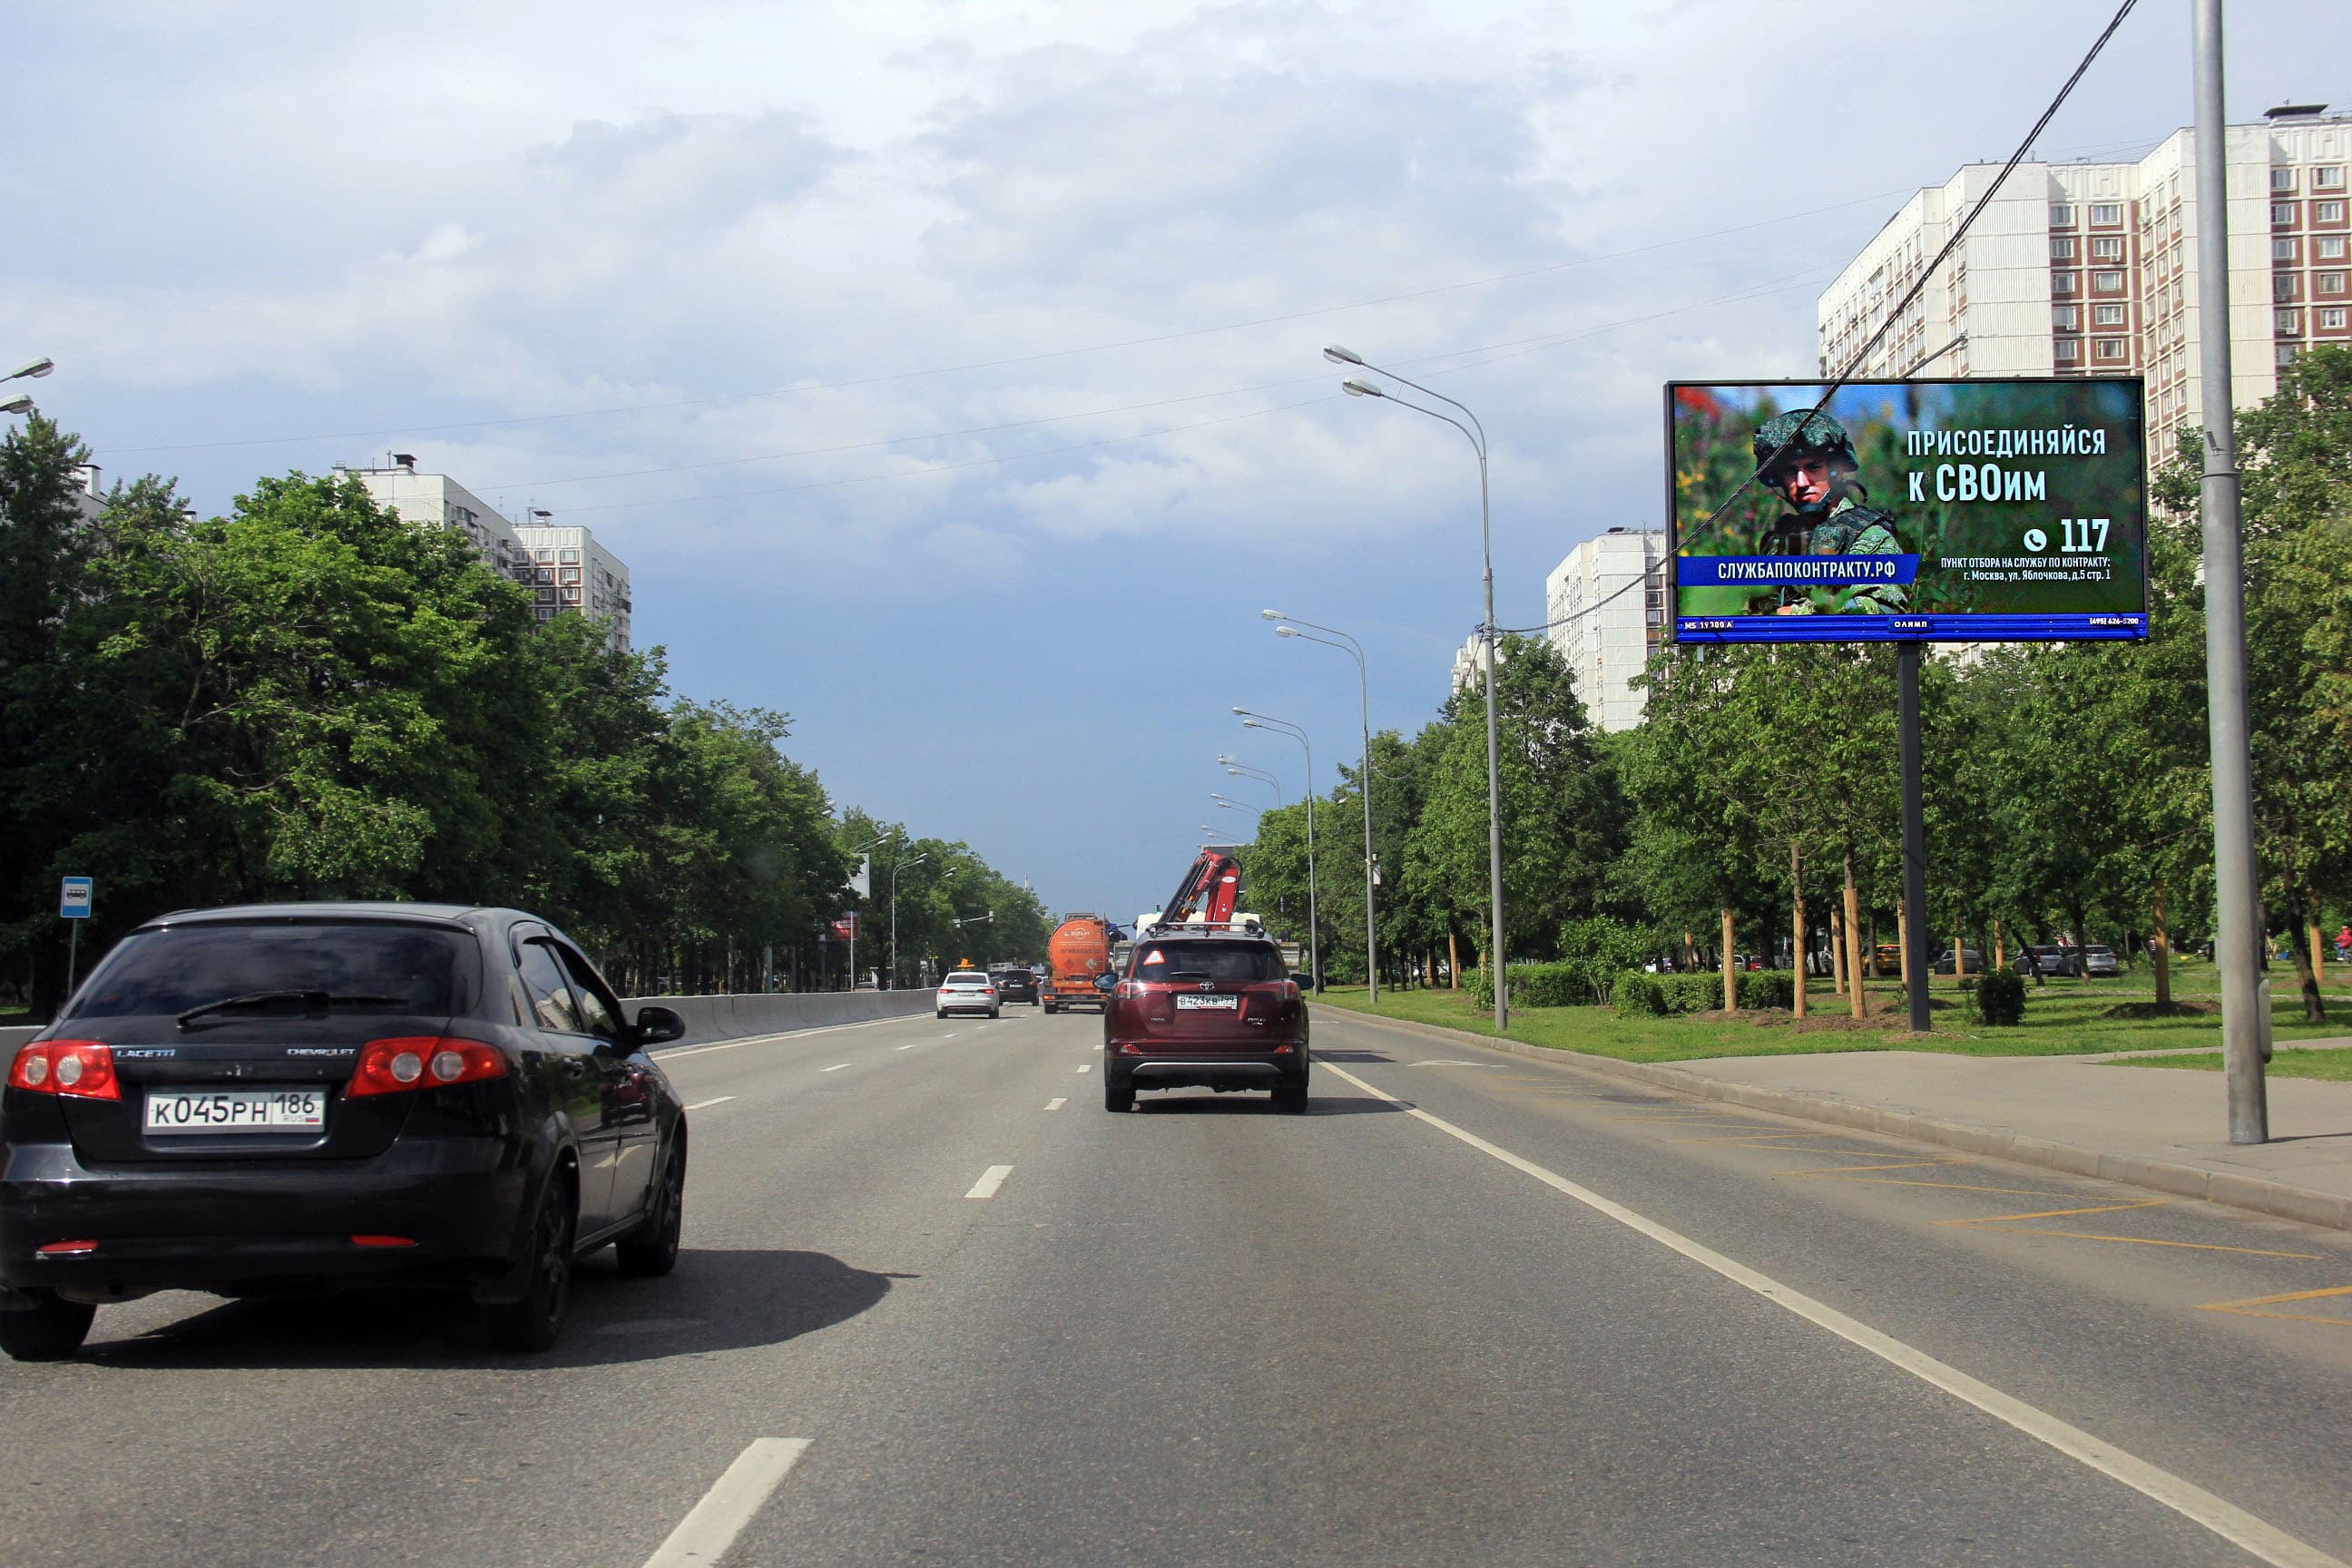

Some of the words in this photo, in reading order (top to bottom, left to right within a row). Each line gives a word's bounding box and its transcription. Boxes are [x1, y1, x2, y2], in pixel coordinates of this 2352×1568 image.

[1907, 424, 2105, 458] ПРИСОЕДИНЯЙСЯ
[2061, 518, 2110, 553] 117
[1941, 557, 1967, 568] ПУНКТ
[1969, 557, 2000, 568] ОТБОРА
[2002, 557, 2013, 568] НА
[2014, 557, 2047, 568] СЛУЖБУ
[2049, 557, 2061, 568] ПО
[2062, 556, 2111, 567] КОНТРАКТУ:
[1718, 561, 1896, 579] СЛУЖБАПОКОНТРАКТУ.РФ
[2105, 570, 2111, 580] 1
[117, 1049, 175, 1058] LACETTI
[287, 1048, 356, 1056] CHEVROLET
[274, 1093, 315, 1114] 186
[283, 1114, 304, 1122] RUS
